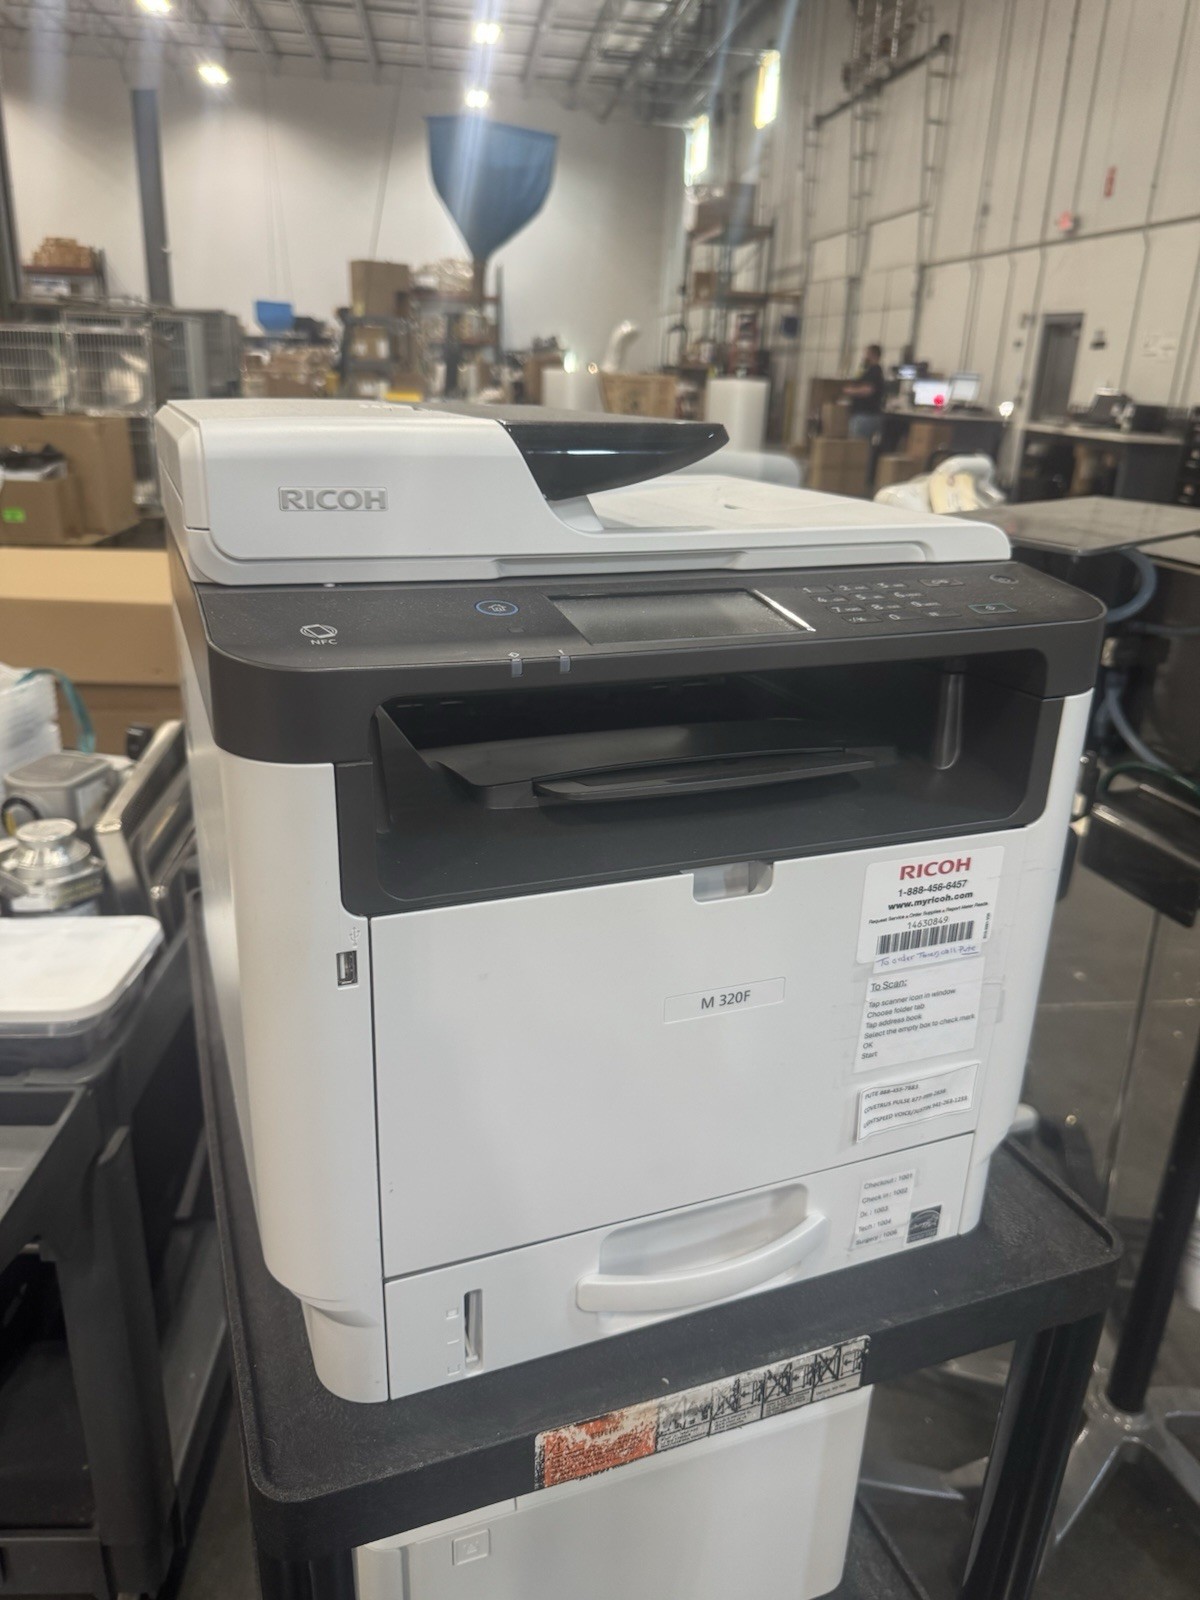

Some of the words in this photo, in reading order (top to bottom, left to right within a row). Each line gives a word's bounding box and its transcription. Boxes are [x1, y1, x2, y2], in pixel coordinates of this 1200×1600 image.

[280, 489, 386, 510] RICOH
[310, 638, 338, 646] NFC
[900, 857, 971, 880] RICOH
[898, 880, 968, 897] 1-888-456-6457
[888, 892, 973, 910] www.myricoh.com
[908, 916, 949, 930] 14630849
[876, 956, 890, 966] To
[870, 982, 881, 992] To
[882, 979, 908, 990] Scan:
[701, 996, 715, 1010] M
[719, 989, 751, 1007] 320F
[868, 1002, 880, 1010] Tap
[880, 996, 908, 1006] scanner
[908, 994, 923, 1002] icon
[932, 988, 956, 998] window
[866, 1009, 892, 1018] Choose
[894, 1004, 914, 1014] folder
[864, 1030, 886, 1040] Select
[886, 1027, 897, 1035] the
[898, 1024, 918, 1034] empty
[939, 1016, 958, 1026] check
[960, 1013, 975, 1022] mark
[866, 1022, 878, 1030] Tap
[878, 1018, 905, 1027] address
[906, 1014, 922, 1022] book
[862, 1041, 874, 1050] OK
[861, 1051, 878, 1060] Start
